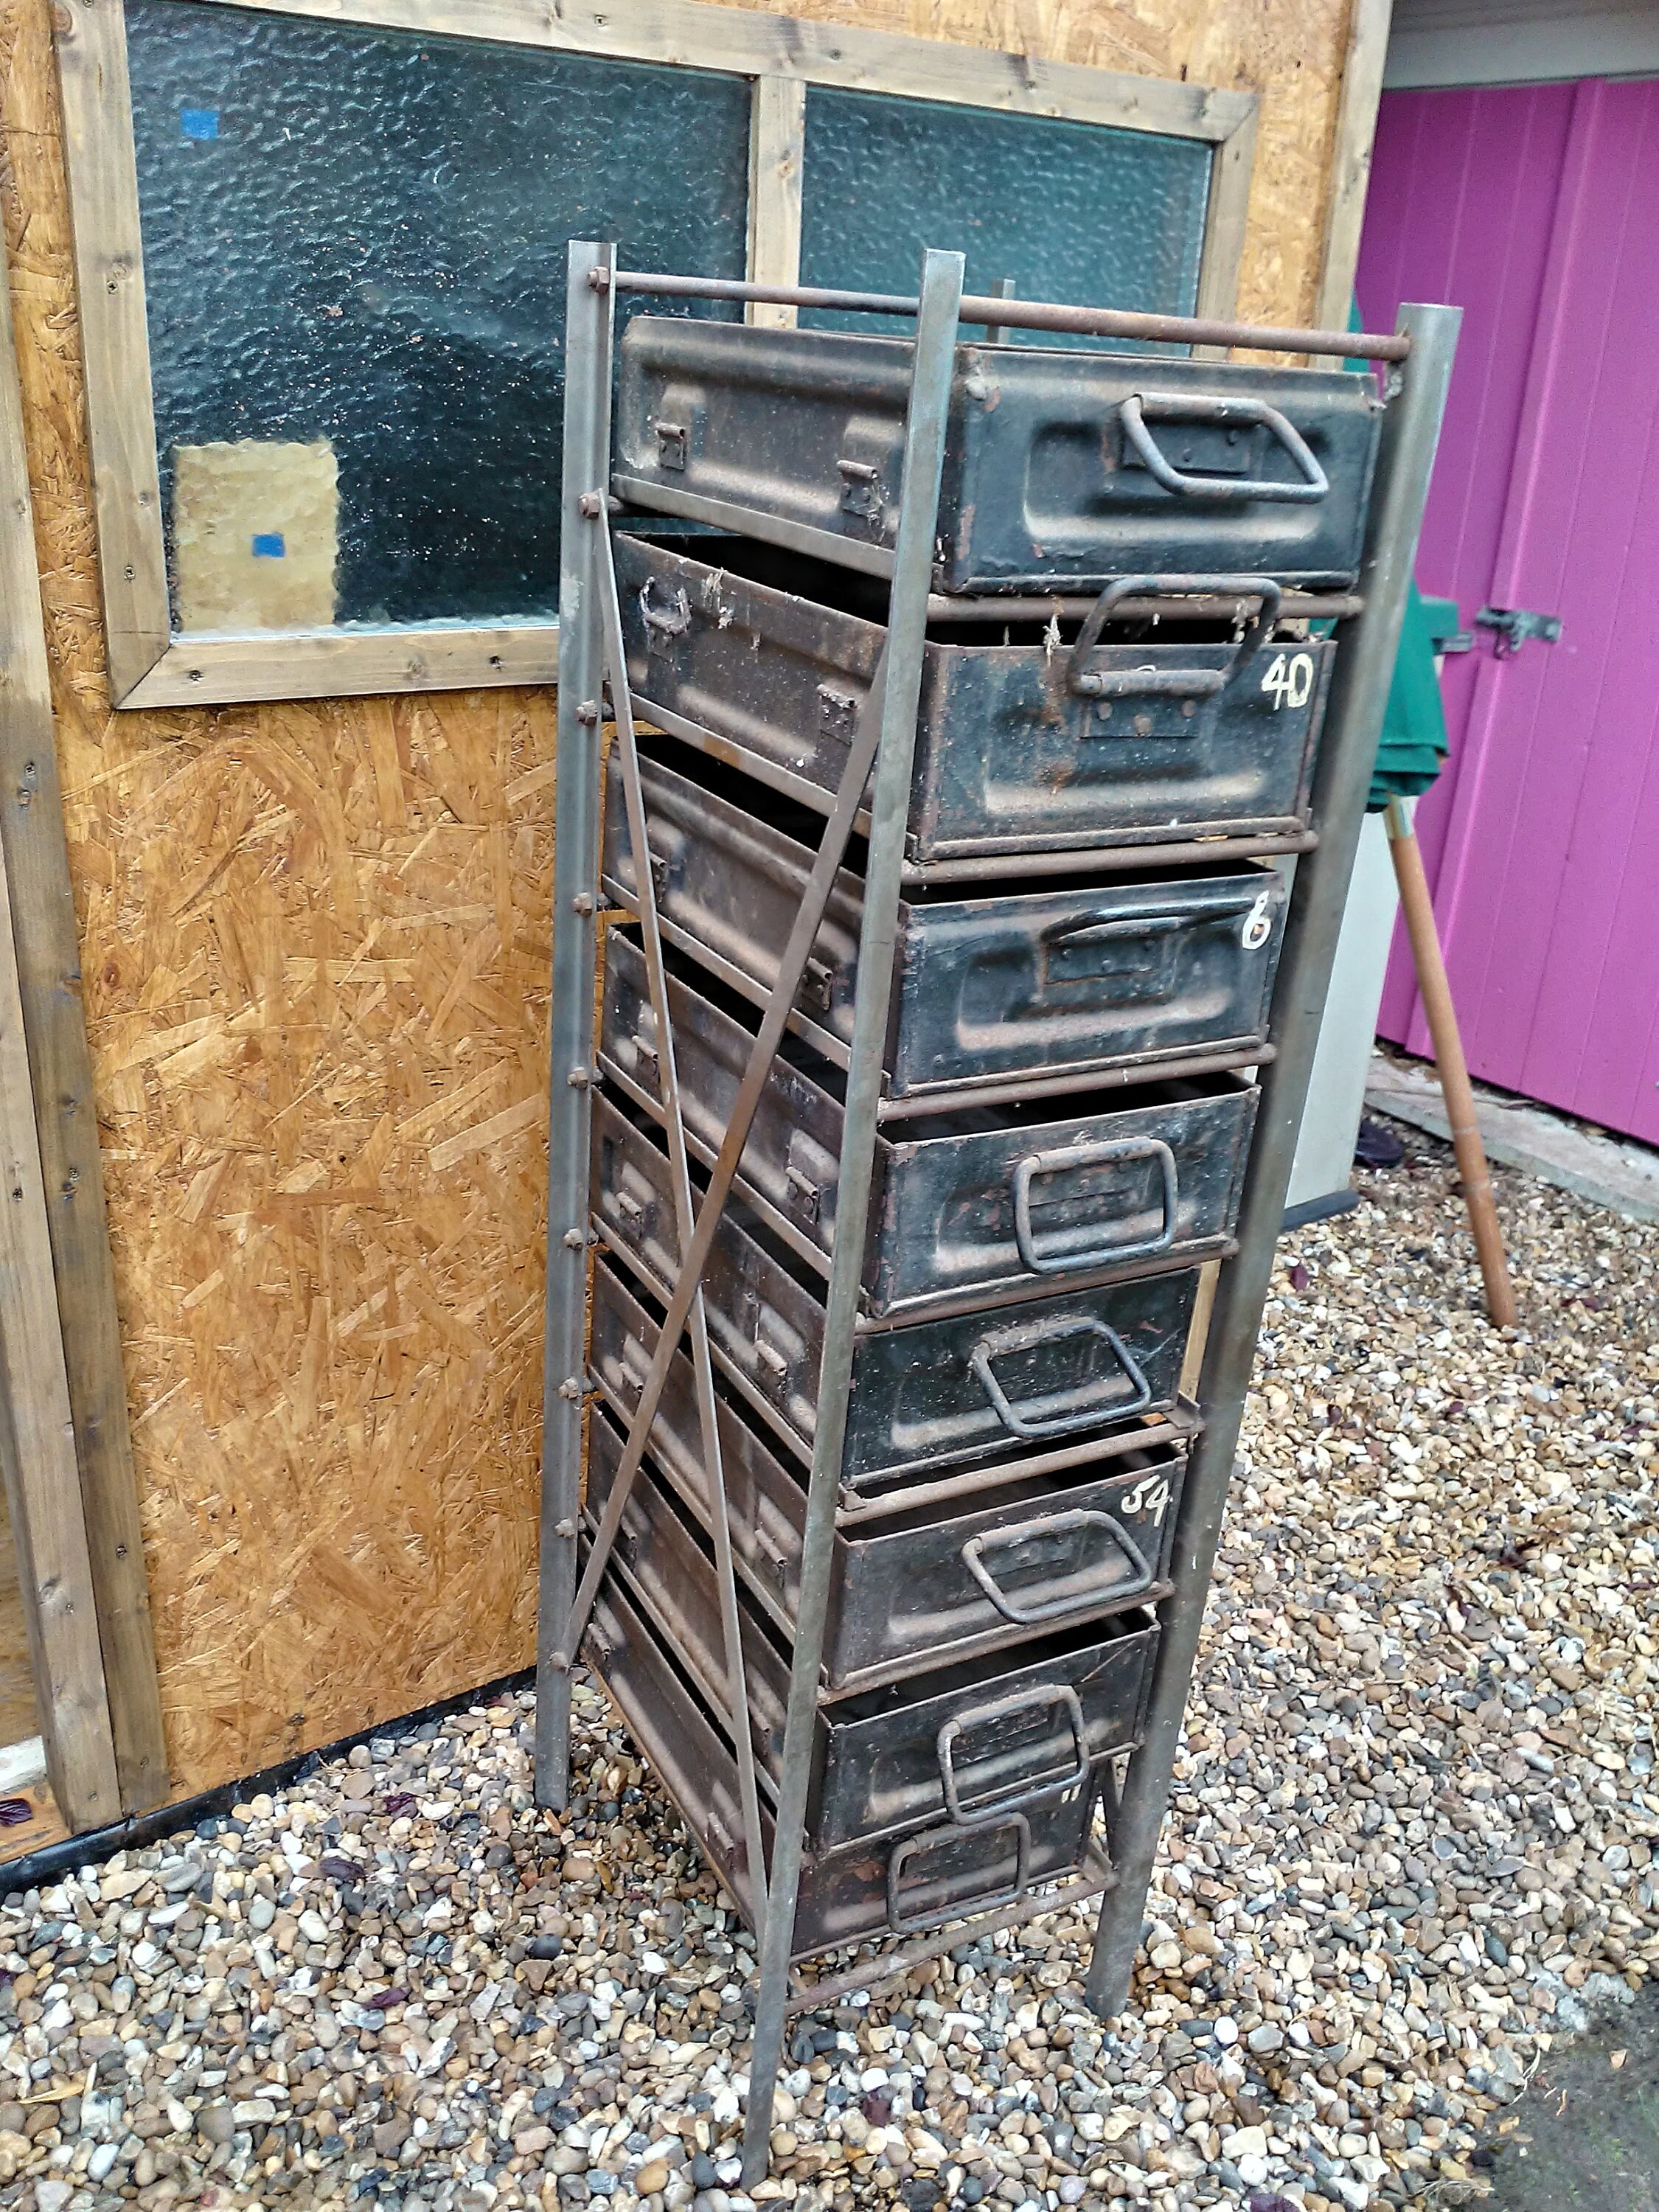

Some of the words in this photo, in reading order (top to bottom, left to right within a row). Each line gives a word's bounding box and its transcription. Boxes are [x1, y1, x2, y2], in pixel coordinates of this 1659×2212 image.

[1261, 653, 1313, 711] 40
[1242, 889, 1272, 950] 6
[1121, 1474, 1171, 1527] 54
